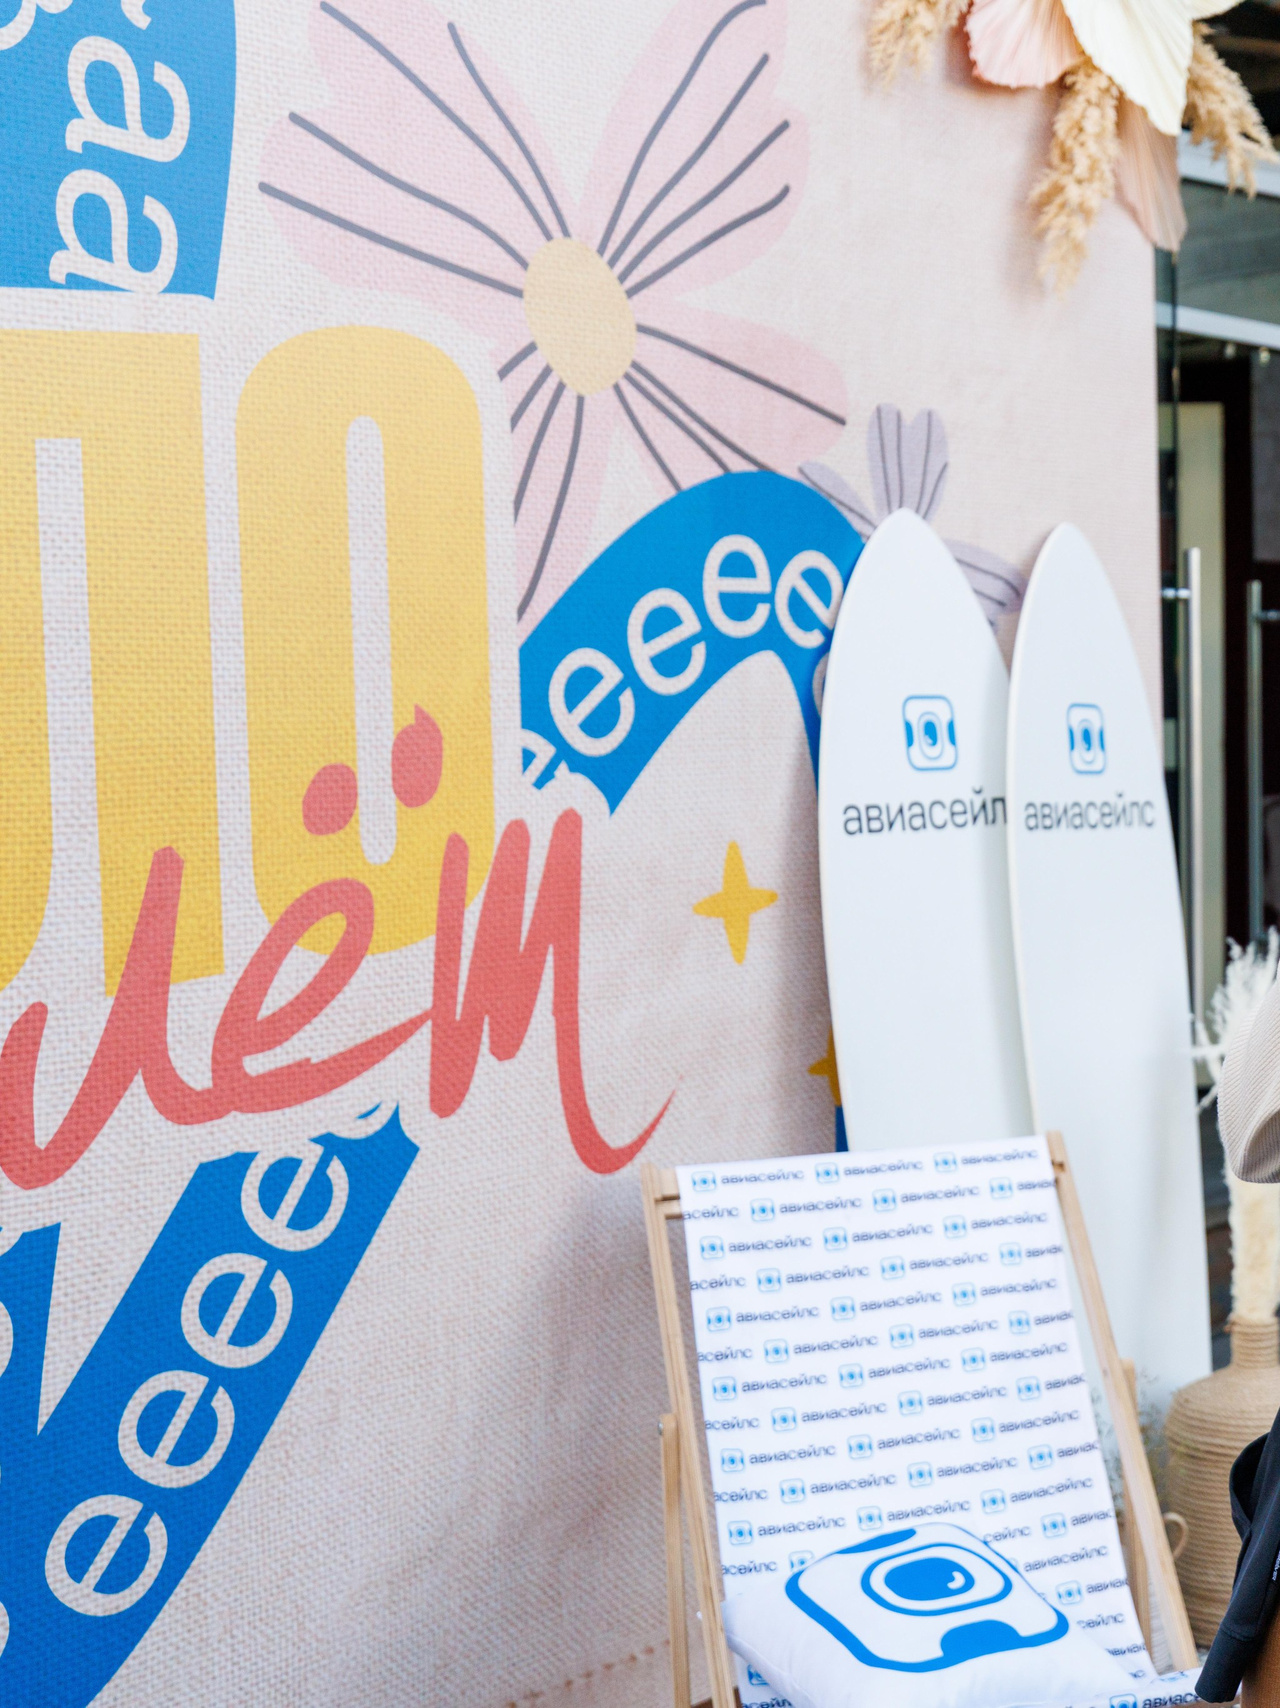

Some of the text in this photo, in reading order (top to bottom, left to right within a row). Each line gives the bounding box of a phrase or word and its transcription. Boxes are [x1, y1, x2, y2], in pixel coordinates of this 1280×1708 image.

[1024, 792, 1155, 832] авиасейлс
[721, 1150, 1037, 1184] авиасейлс авиасейлс авиасейлс
[780, 1195, 862, 1213] авиасейлс
[901, 1186, 979, 1203] авиасейлс
[729, 1212, 1047, 1252] авиасейлс авиасейлс авиасейлс
[786, 1264, 869, 1283] авиасейлс
[910, 1252, 987, 1270] авиасейлс
[736, 1277, 1057, 1323] авиасейлс авиасейлс авиасейлс
[794, 1334, 878, 1354] авиасейлс
[919, 1318, 998, 1338] авиасейлс
[742, 1341, 1068, 1393] авиасейлс авиасейлс авиасейлс
[802, 1401, 887, 1422] авиасейлс
[927, 1384, 1007, 1406] авиасейлс
[749, 1409, 1079, 1464] авиасейлс авиасейлс авиасейлс
[810, 1472, 897, 1494] авиасейлс
[937, 1456, 1017, 1477] авиасейлс
[758, 1476, 1093, 1537] авиасейлс авиасейлс авиасейлс
[1023, 1545, 1108, 1573] авиасейлс
